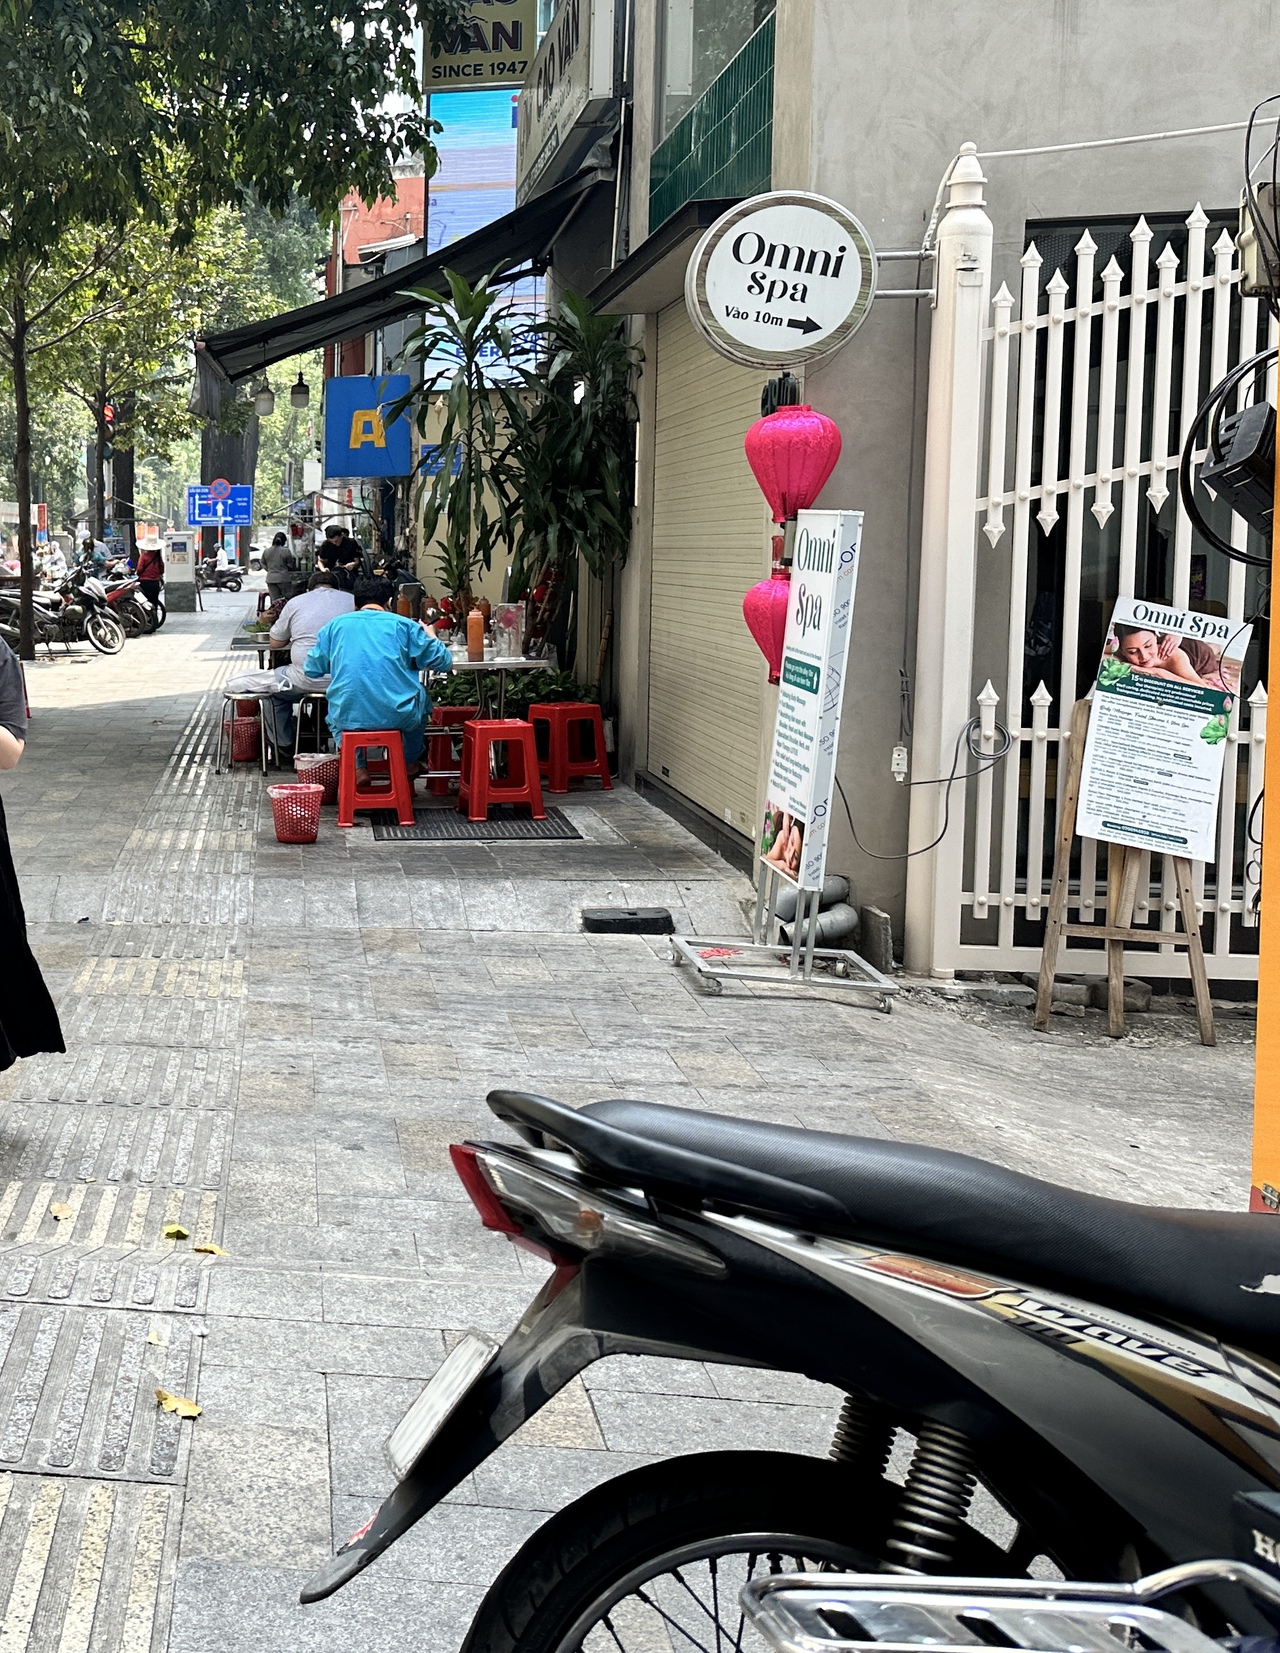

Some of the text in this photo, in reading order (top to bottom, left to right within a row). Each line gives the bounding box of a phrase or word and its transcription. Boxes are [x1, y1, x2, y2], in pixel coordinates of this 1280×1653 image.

[431, 60, 528, 80] SINCE 1947
[536, 42, 555, 123] CAO
[732, 231, 847, 279] Omni
[746, 270, 809, 304] Spa
[724, 304, 783, 327] Vào 10m
[797, 528, 836, 574] Omni
[796, 583, 822, 639] Spa
[1132, 603, 1187, 630] Omni
[1189, 614, 1229, 640] Spa
[1060, 1300, 1197, 1356] SPLENDID MOVER
